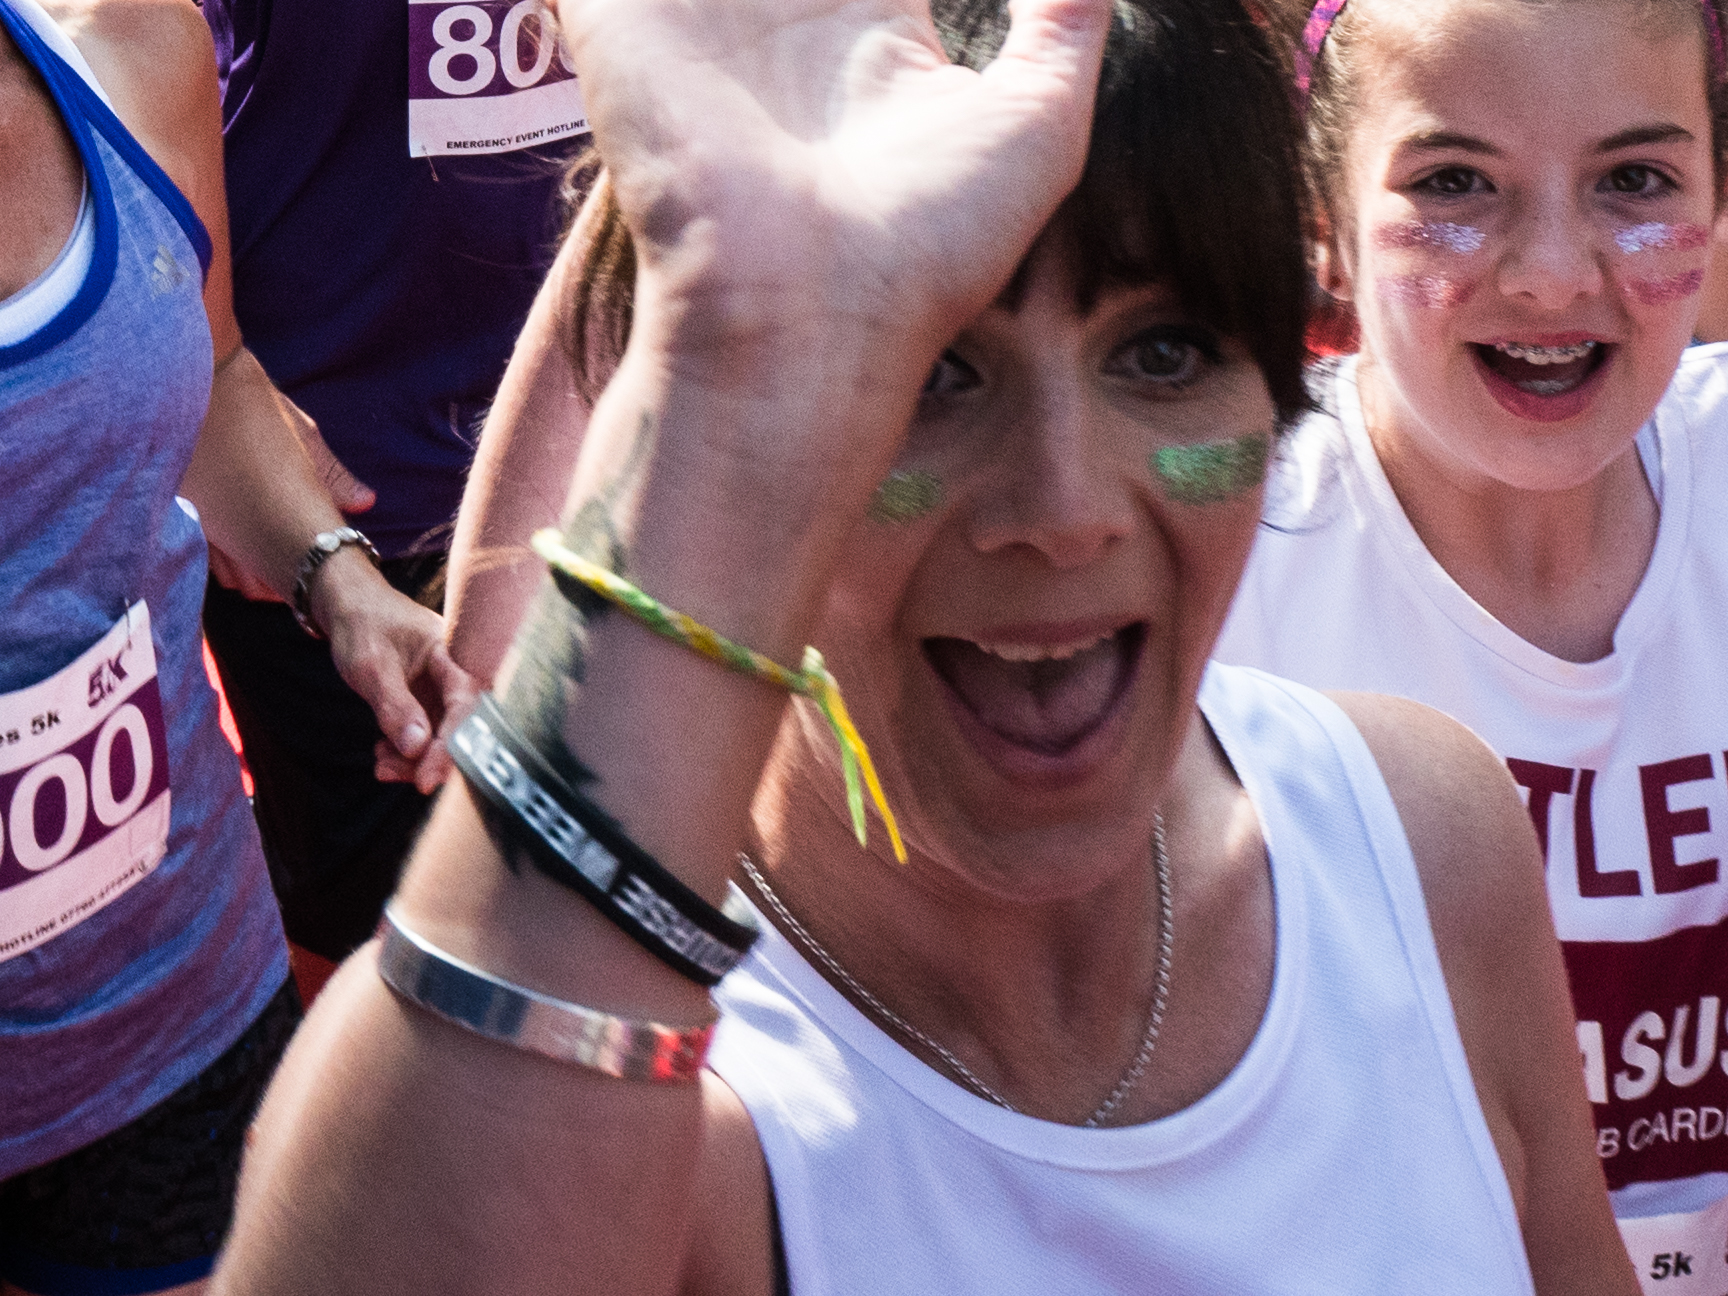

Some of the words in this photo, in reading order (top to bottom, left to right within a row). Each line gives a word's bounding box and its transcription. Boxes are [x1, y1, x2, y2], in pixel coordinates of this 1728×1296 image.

[446, 136, 513, 149] EMERGENCY
[515, 128, 546, 144] EVENT
[547, 118, 586, 135] HOTLINE
[30, 709, 62, 738] 5k
[1649, 1251, 1693, 1281] 5k
